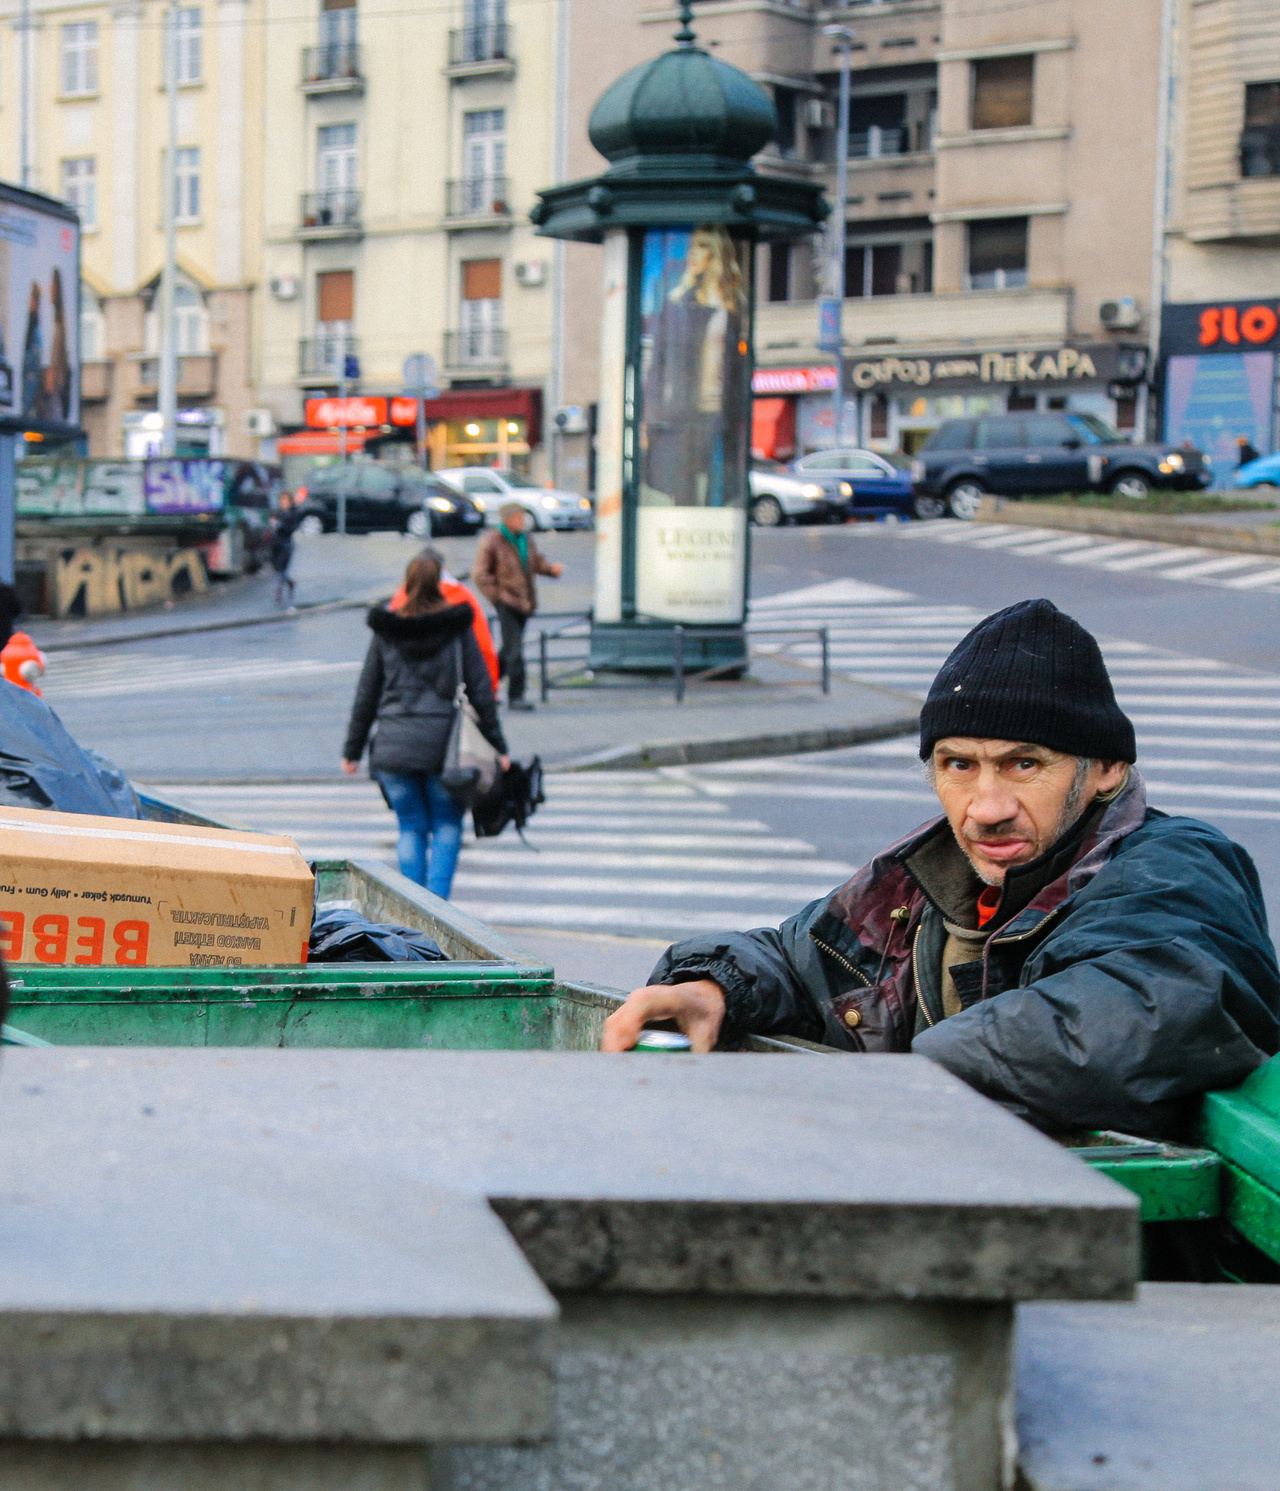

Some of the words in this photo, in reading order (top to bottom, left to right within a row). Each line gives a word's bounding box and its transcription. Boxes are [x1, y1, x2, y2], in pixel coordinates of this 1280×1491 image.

[1199, 305, 1280, 347] SLO
[25, 887, 49, 897] Gum
[50, 887, 71, 899] Jelly
[80, 891, 108, 902] Şeker
[110, 893, 153, 904] Yumuşak
[216, 935, 262, 950] BARKOD
[189, 954, 226, 965] ALANA
